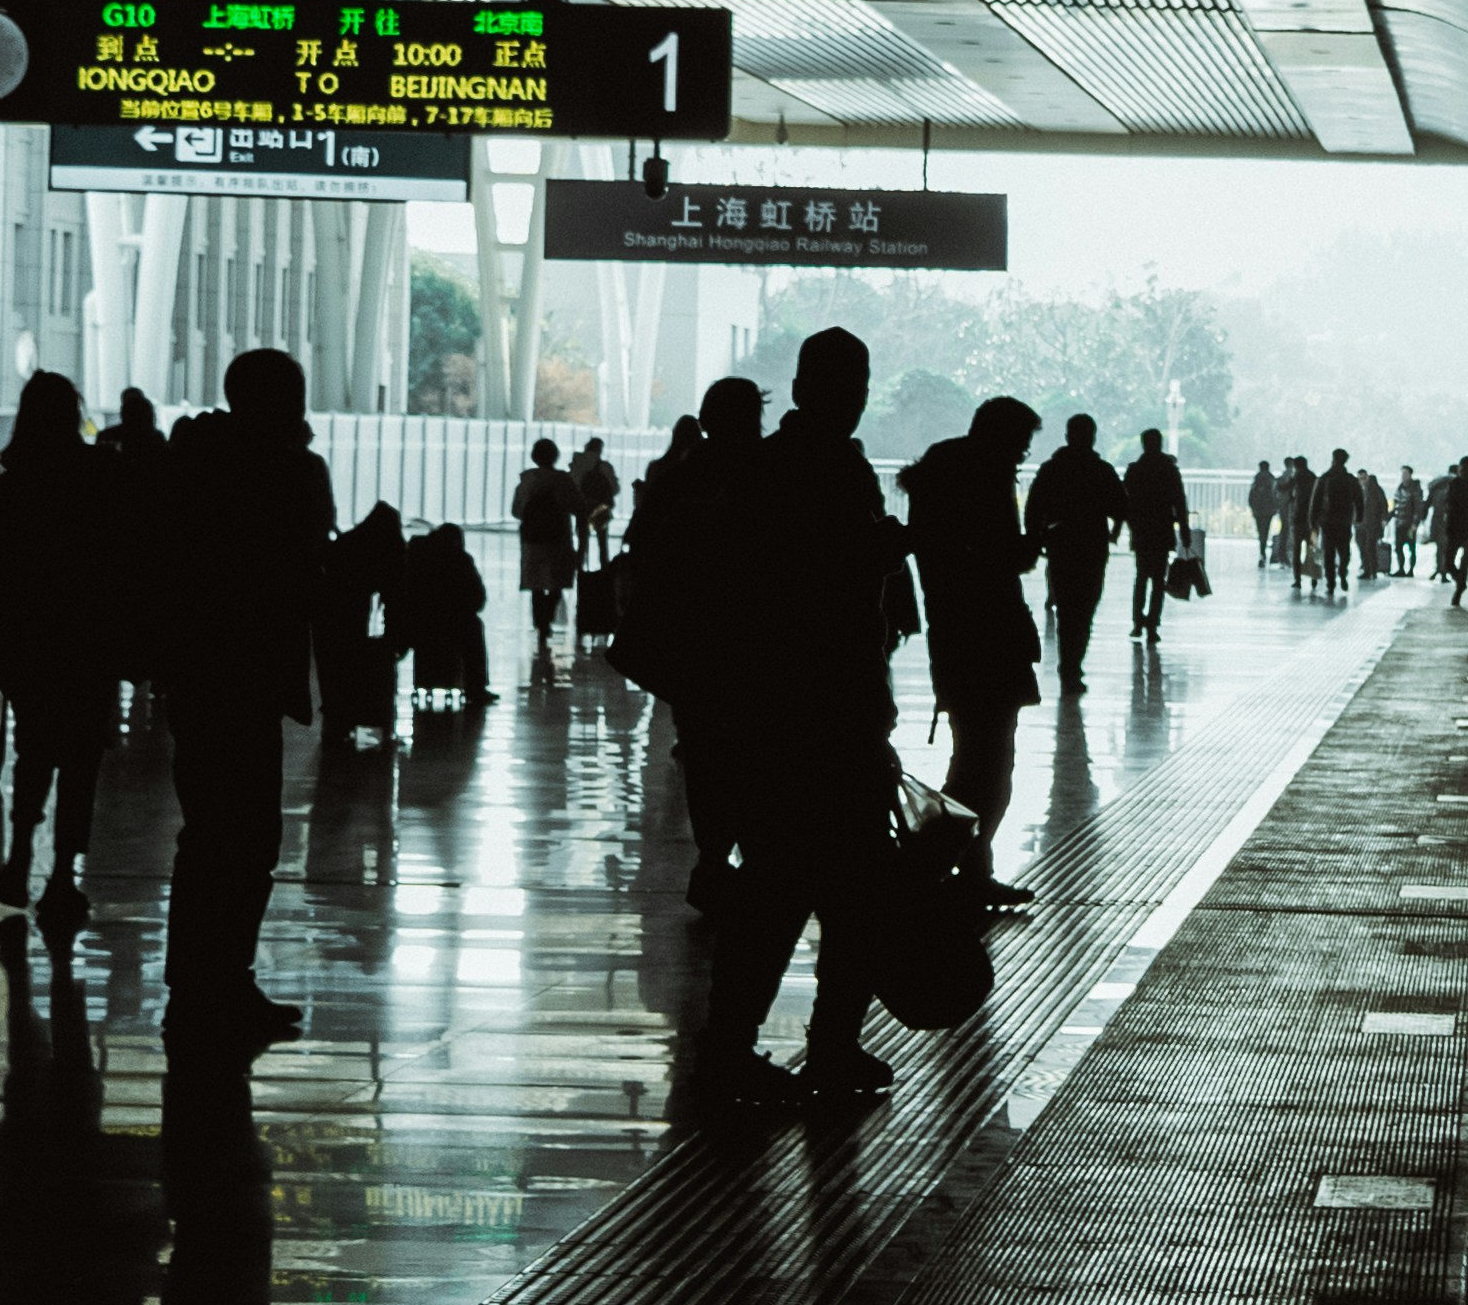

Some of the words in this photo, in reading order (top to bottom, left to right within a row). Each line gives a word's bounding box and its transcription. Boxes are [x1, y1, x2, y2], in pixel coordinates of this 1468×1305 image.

[102, 3, 156, 27] G10
[202, 4, 295, 30] 上海虹桥
[340, 8, 400, 36] 开往
[474, 11, 543, 36] 北京南
[97, 35, 159, 62] 到点
[297, 39, 358, 66] 开点
[394, 43, 462, 66] 10:00
[493, 41, 546, 68] 正点
[390, 75, 547, 101] BEIJINGNAN
[650, 32, 678, 111] 1
[671, 196, 881, 232] 上海虹桥站
[623, 232, 703, 252] Shanghai
[709, 235, 790, 255] Hongqiao
[796, 238, 864, 257] Railway
[870, 241, 929, 257] Station
